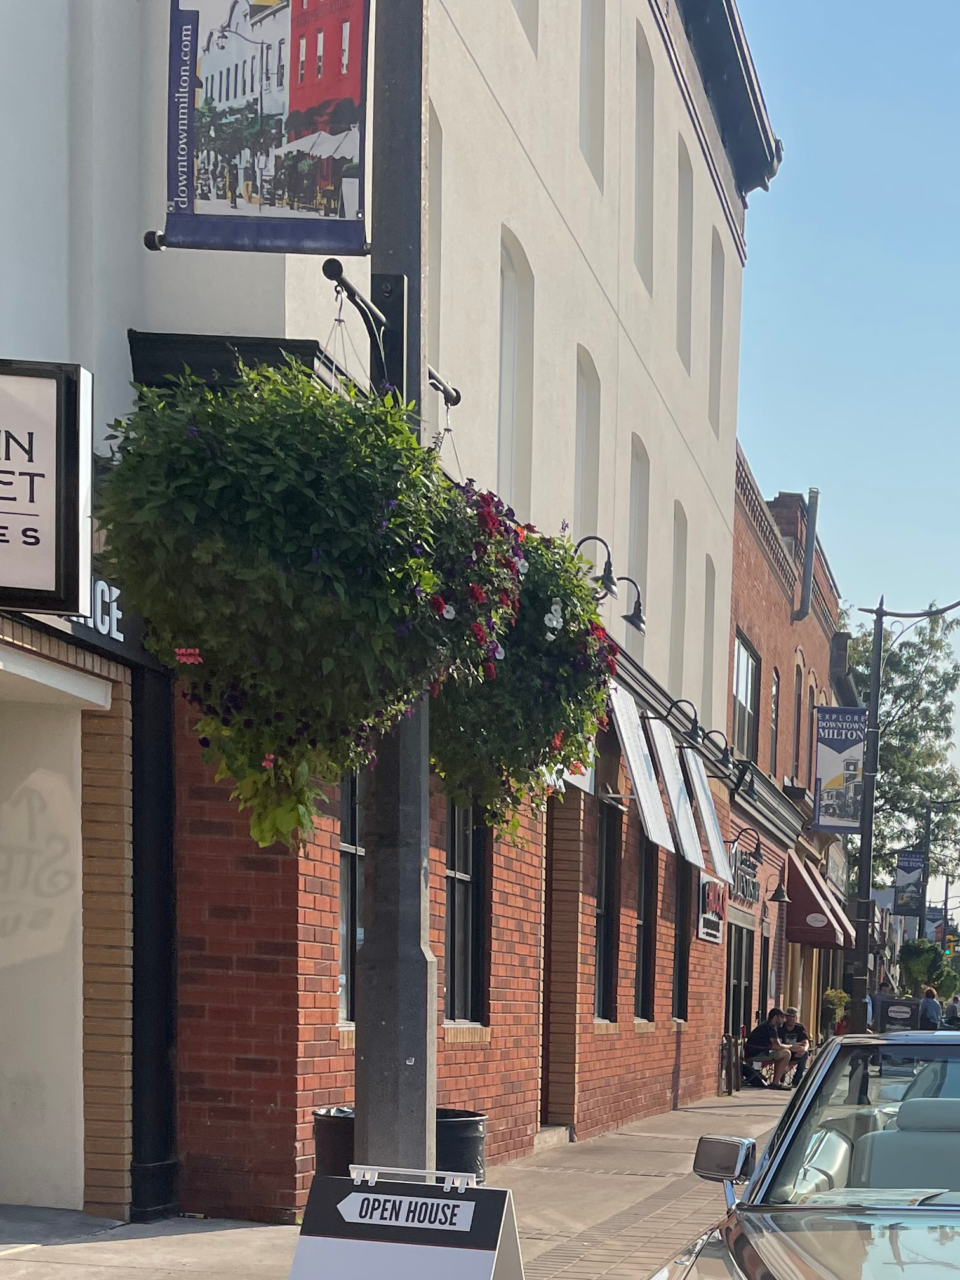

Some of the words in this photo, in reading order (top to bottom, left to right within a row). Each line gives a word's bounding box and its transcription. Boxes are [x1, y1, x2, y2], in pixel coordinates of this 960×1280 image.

[174, 24, 192, 209] downtownmilton.com
[0, 430, 34, 462] N
[818, 713, 865, 722] EXPLORE
[818, 721, 865, 729] DOWNTOWN
[818, 728, 865, 740] MILTON
[359, 1197, 402, 1221] OPEN
[405, 1200, 460, 1227] HOUSE
